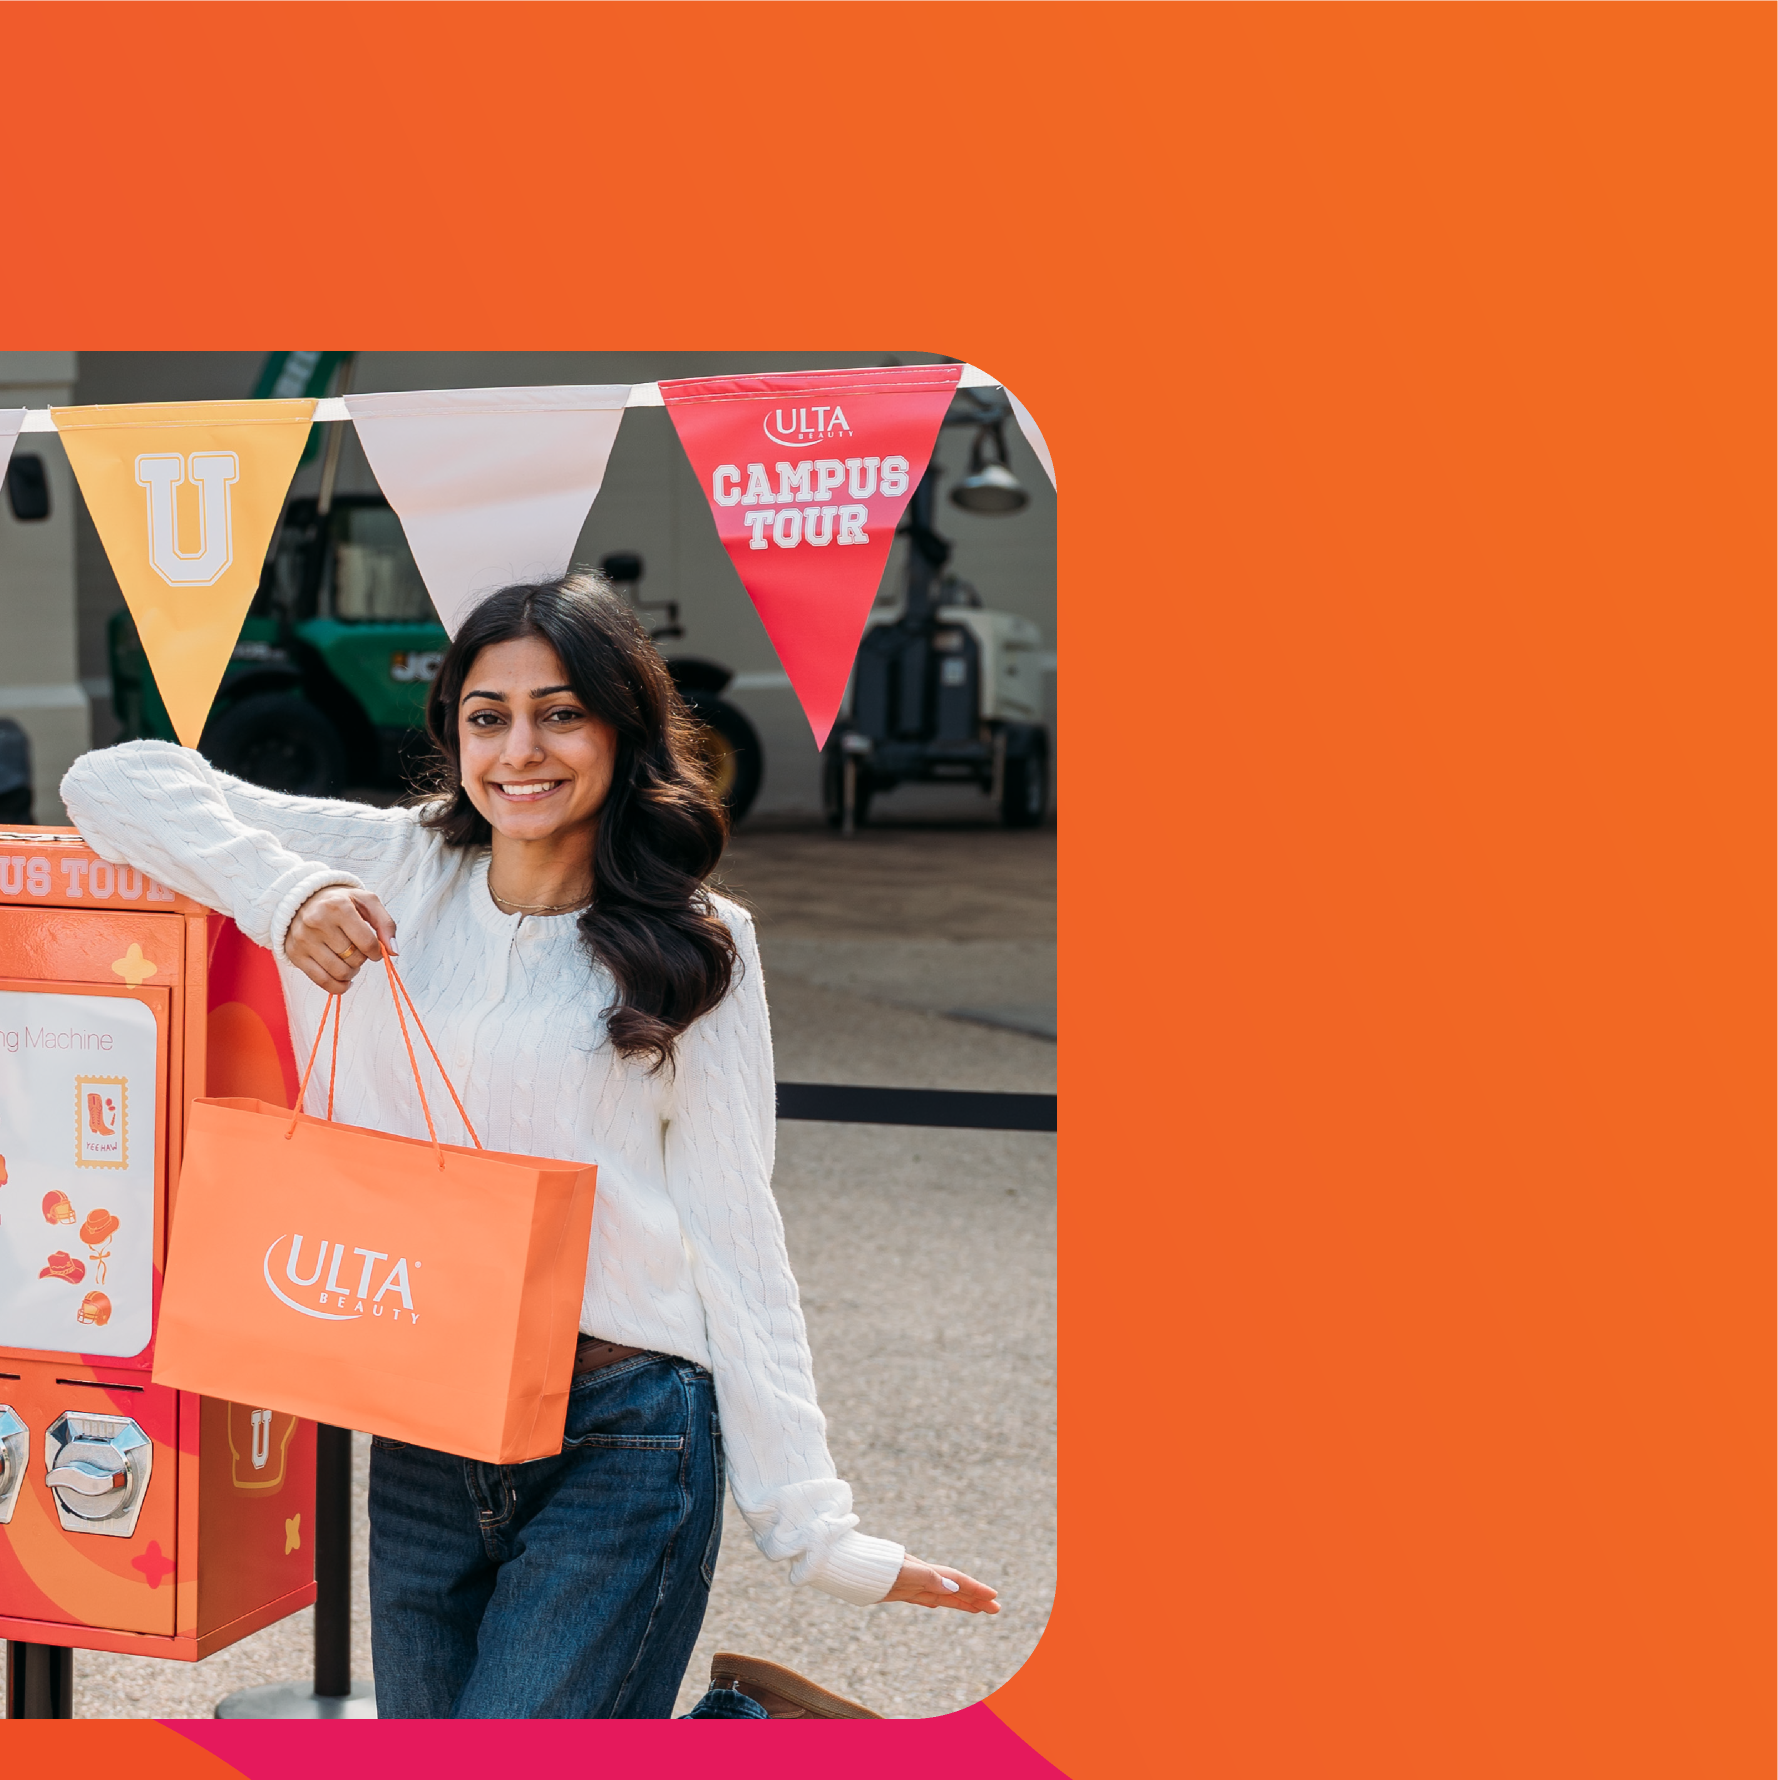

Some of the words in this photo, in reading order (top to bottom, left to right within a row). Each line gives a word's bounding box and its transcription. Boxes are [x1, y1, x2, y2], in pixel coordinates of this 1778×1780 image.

[775, 406, 850, 434] ULTA
[798, 430, 854, 440] BEAUTY
[712, 454, 910, 508] CAMPUS
[134, 450, 240, 588] U
[744, 503, 870, 550] TOUR
[392, 654, 441, 682] JC
[25, 1027, 114, 1052] Machine
[285, 1233, 414, 1310] ULTA
[318, 1291, 422, 1326] BEAUTY
[248, 1407, 273, 1470] U
